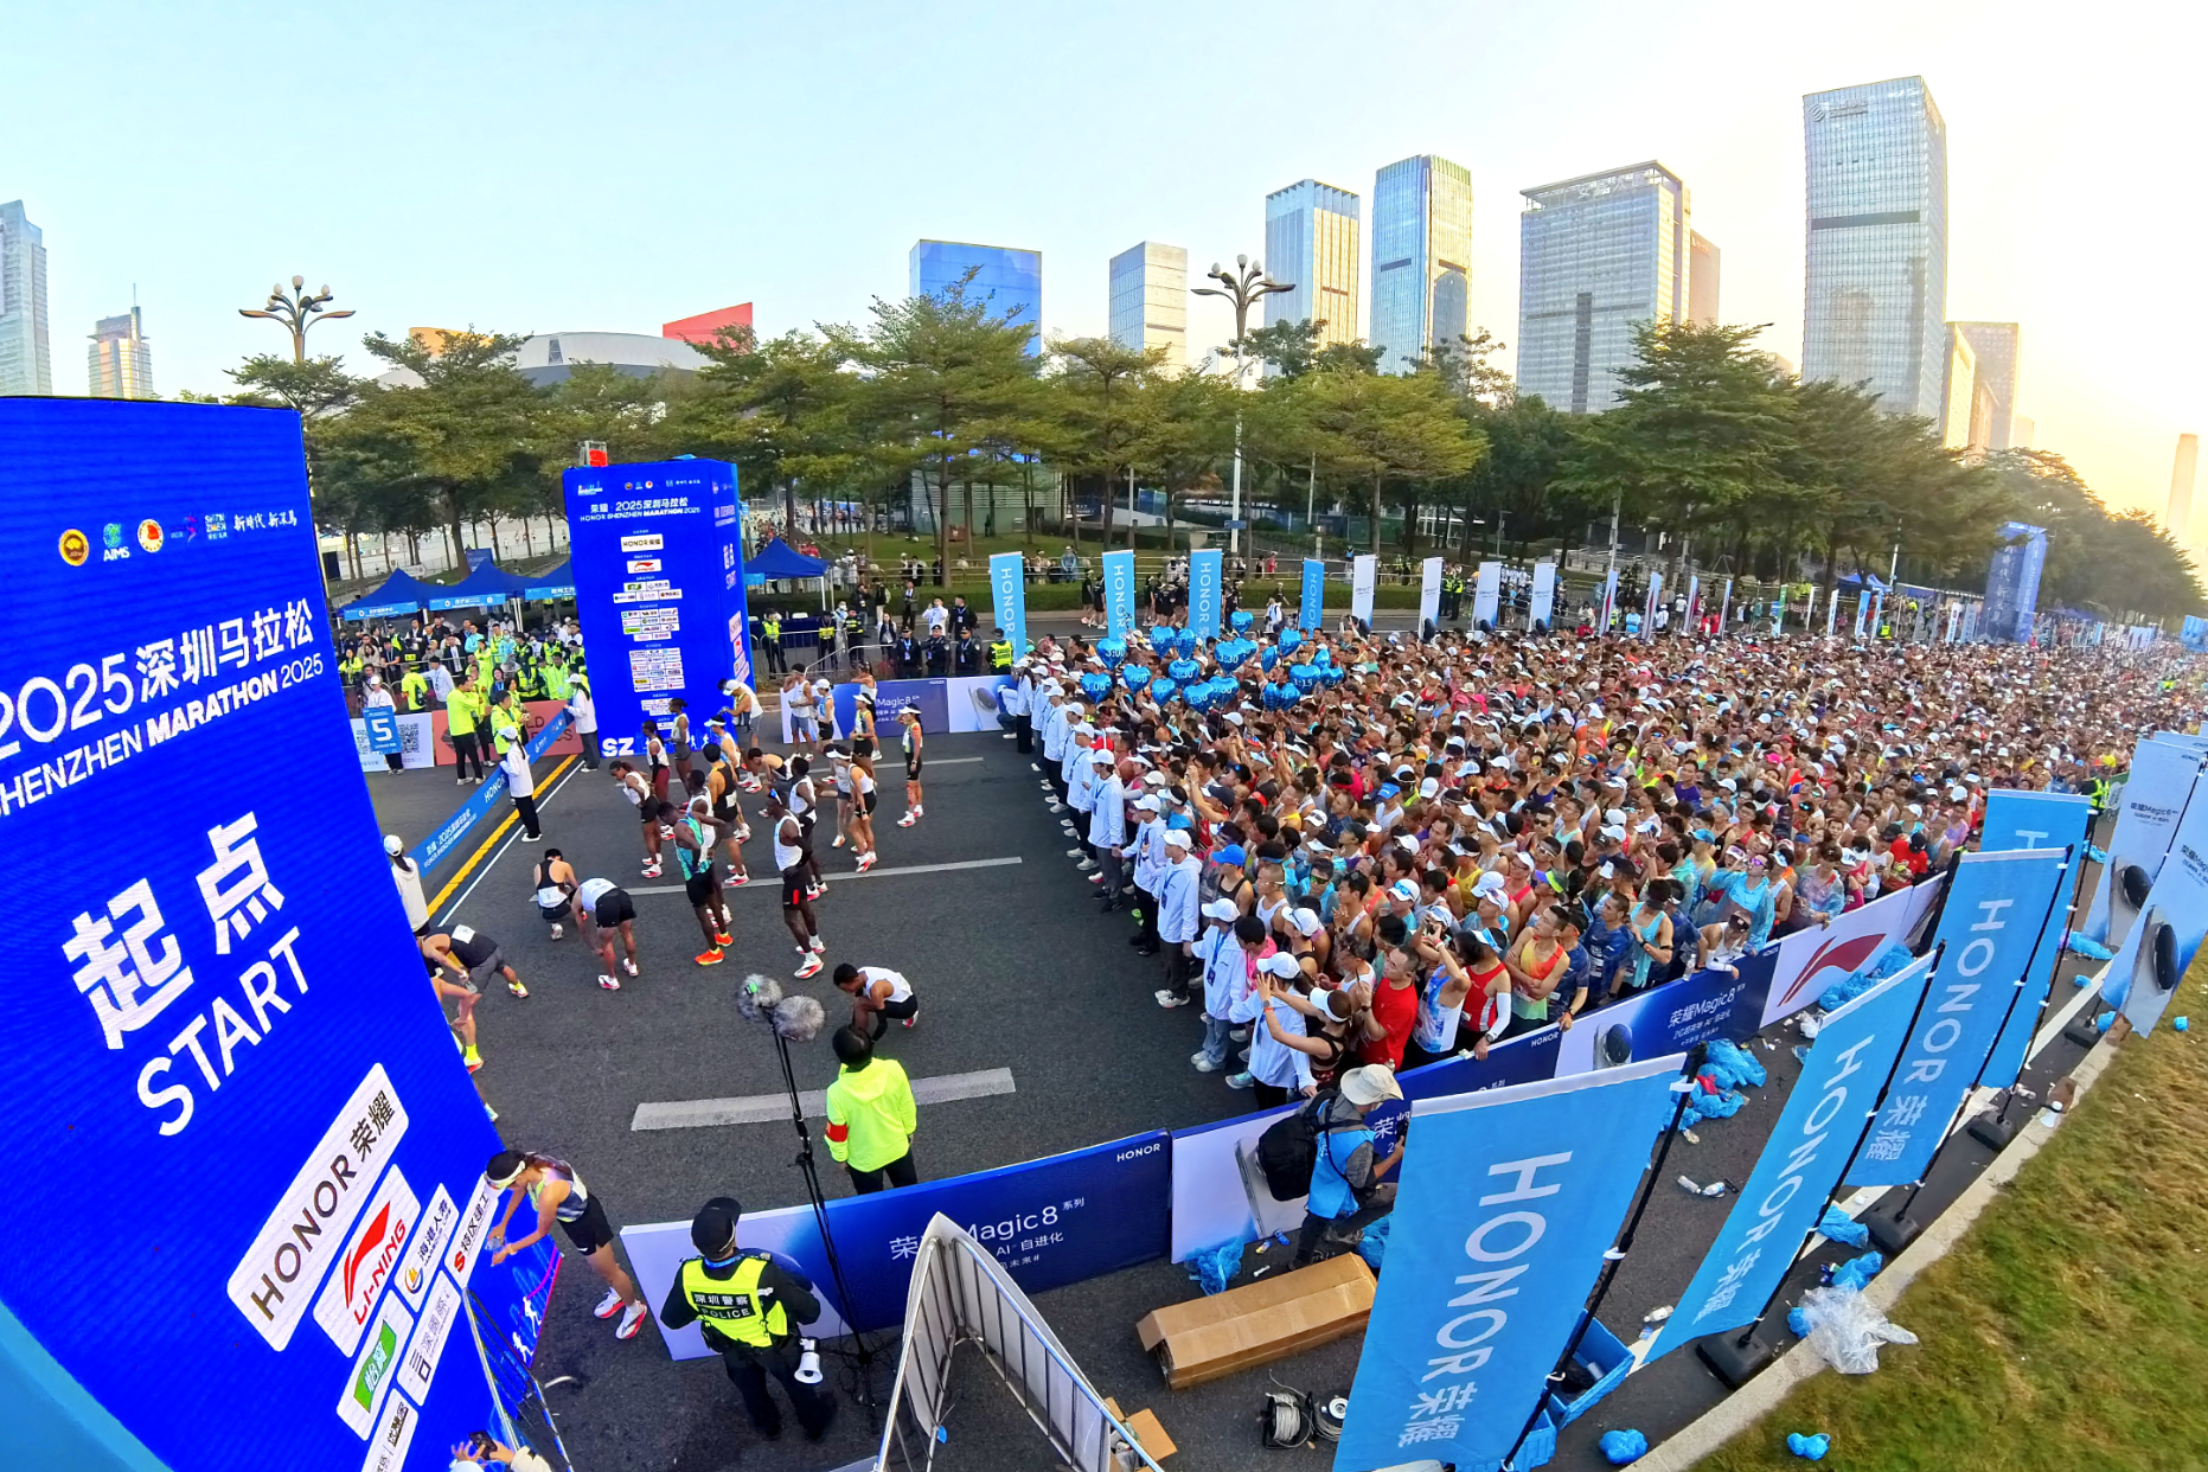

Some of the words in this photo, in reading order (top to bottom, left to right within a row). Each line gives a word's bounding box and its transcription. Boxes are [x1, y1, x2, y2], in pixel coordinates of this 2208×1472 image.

[580, 514, 606, 522] HONOR
[643, 508, 684, 517] MARATHON
[104, 547, 130, 562] AIMS
[1000, 567, 1016, 634] HONOR
[1113, 564, 1126, 630] HONOR
[1200, 562, 1211, 624] HONOR
[1307, 572, 1318, 632] HONOR
[1105, 649, 1125, 658] 3:00
[1219, 654, 1239, 664] 3:30
[0, 724, 143, 818] HENZHEN
[146, 670, 278, 748] MARATHON
[281, 653, 324, 690] 2025
[371, 718, 393, 742] 5
[601, 737, 635, 758] SZ
[62, 810, 286, 1050] 起点
[1903, 898, 2014, 1084] HONOR
[136, 925, 310, 1137] START
[1531, 1031, 1559, 1048] HONOR
[1116, 1142, 1162, 1163] HONOR
[1735, 1033, 1875, 1254] HONOR
[1864, 1094, 1929, 1161] 荣耀
[251, 1154, 357, 1322] HONOR
[349, 1089, 396, 1163] 荣耀
[1062, 1197, 1085, 1211] 系列
[353, 1218, 408, 1326] LI-NING
[1020, 1231, 1064, 1251] 自进化
[1421, 1150, 1574, 1383] HONOR
[694, 1292, 749, 1306] 深圳警察
[701, 1307, 751, 1319] POLICE
[1692, 1248, 1762, 1326] 荣耀
[1398, 1381, 1478, 1448] 荣耀
